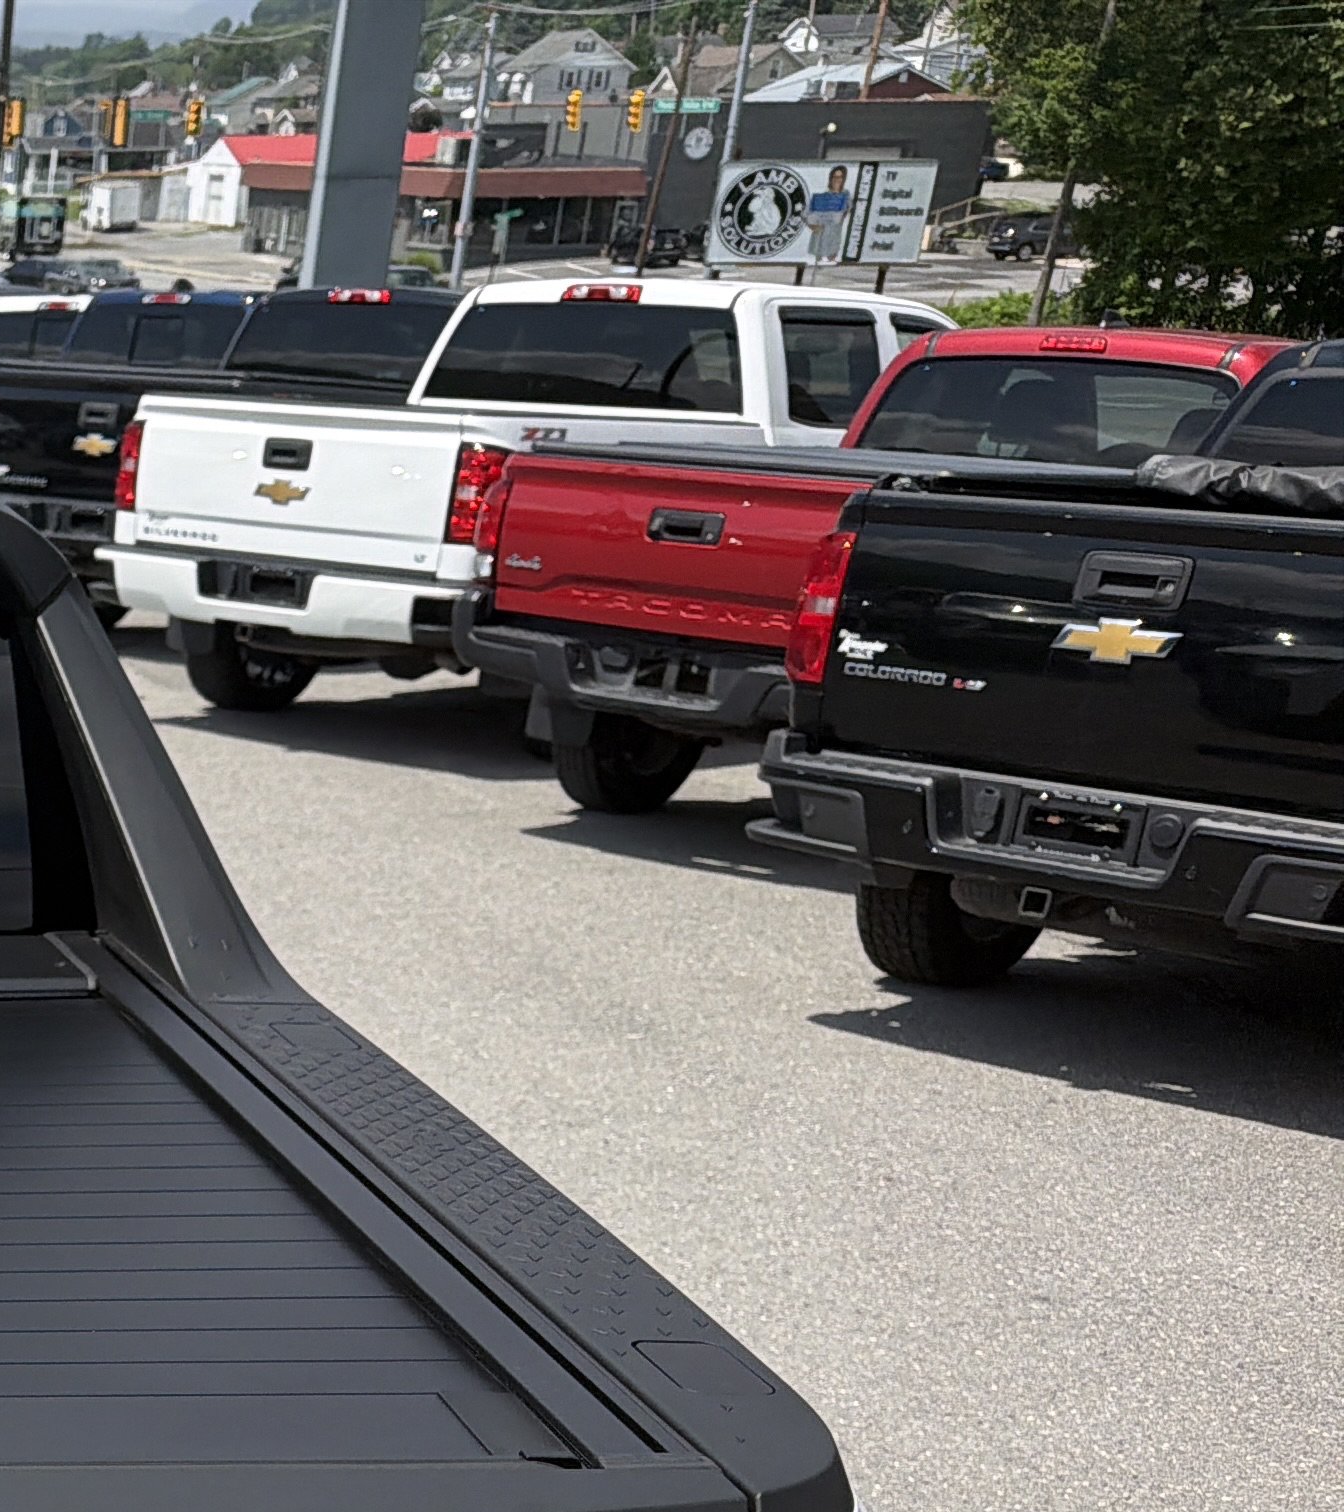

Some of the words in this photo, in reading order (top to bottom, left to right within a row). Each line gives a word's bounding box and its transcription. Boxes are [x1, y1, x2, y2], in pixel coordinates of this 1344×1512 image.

[738, 169, 800, 194] LAMB
[720, 215, 802, 256] SOLUTIONS
[570, 588, 793, 631] TACOMA
[843, 661, 947, 687] COLORADO
